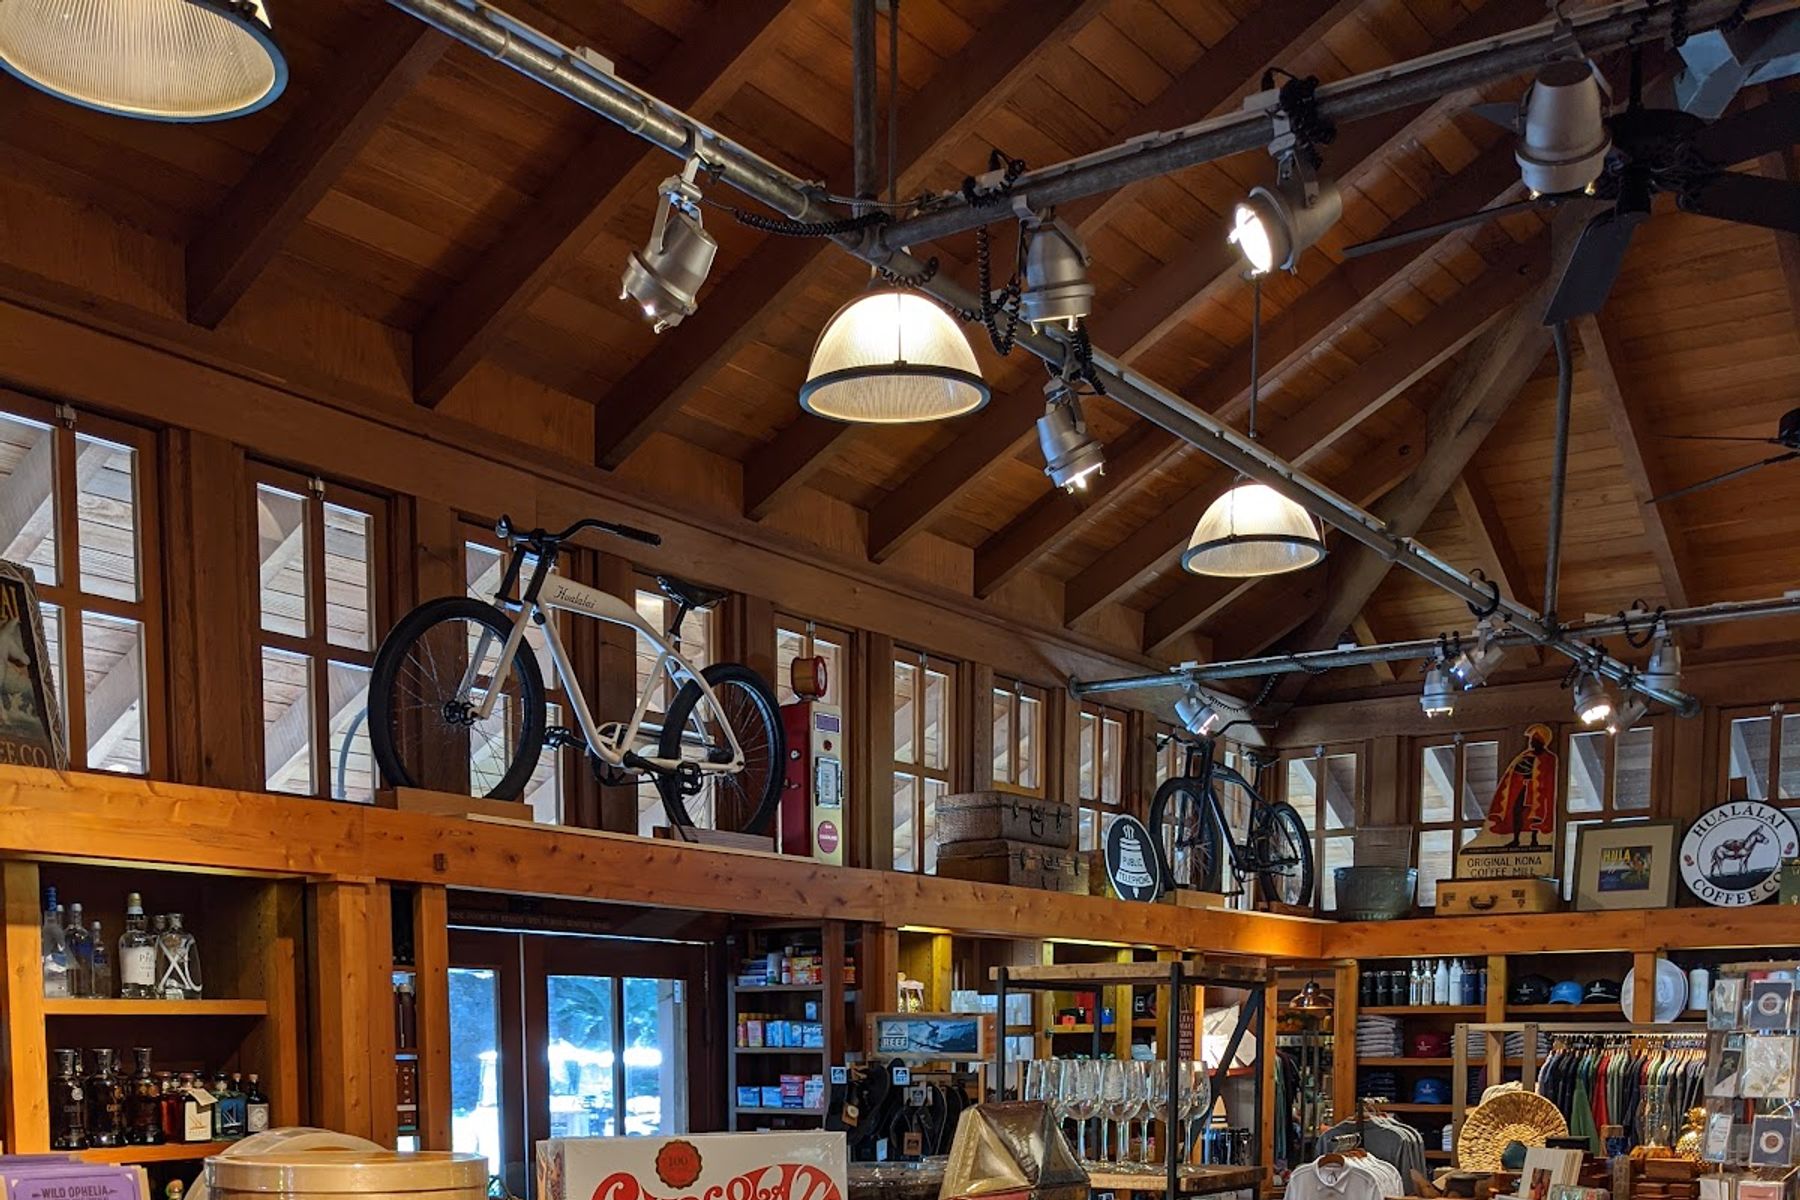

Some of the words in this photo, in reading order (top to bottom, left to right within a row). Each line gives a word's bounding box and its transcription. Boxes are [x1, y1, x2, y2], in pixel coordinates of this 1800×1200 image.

[1466, 857, 1511, 869] ORIGINAL
[1514, 855, 1542, 866] KONA
[1470, 867, 1506, 878] COFFEE
[1692, 878, 1760, 905] COFFEE
[883, 1038, 907, 1048] REEF
[41, 1187, 66, 1199] WILD
[68, 1185, 108, 1198] OPHELIA
